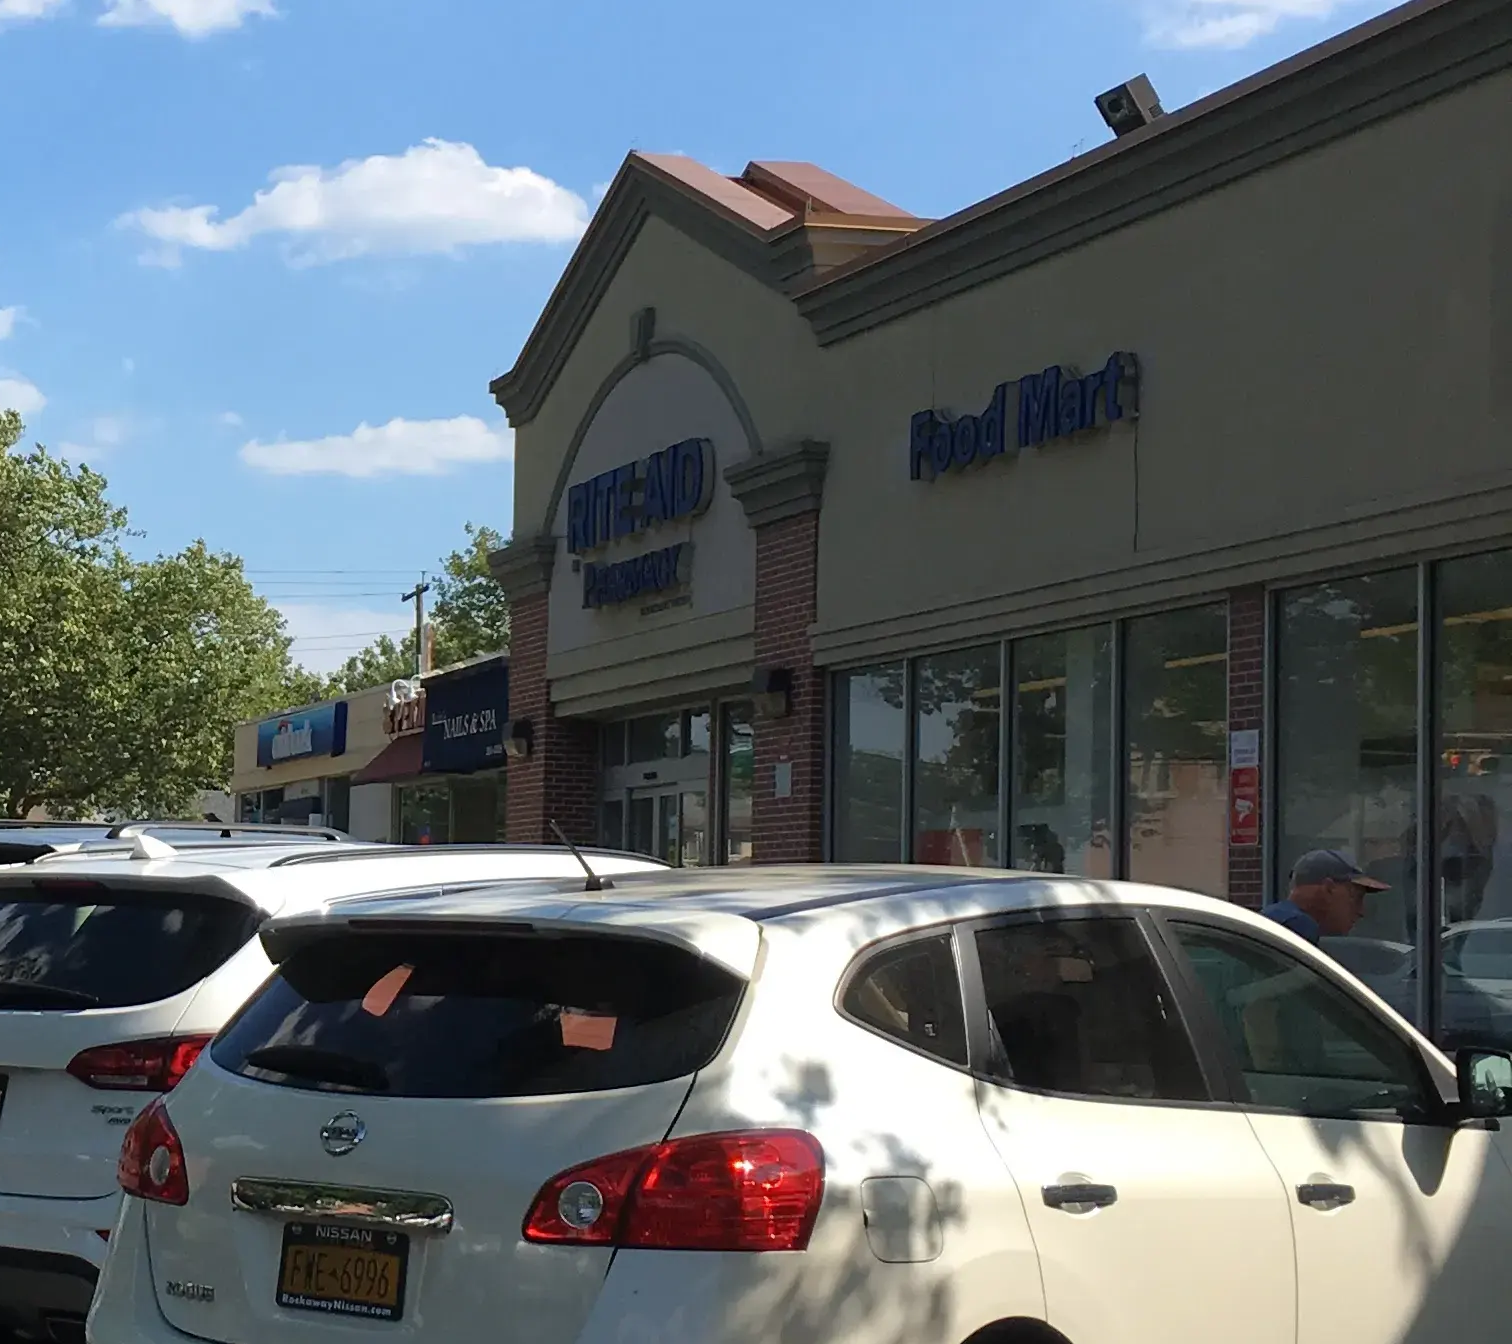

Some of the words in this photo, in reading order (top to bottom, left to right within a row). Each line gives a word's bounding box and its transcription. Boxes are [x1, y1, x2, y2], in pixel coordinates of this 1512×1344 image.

[909, 383, 1007, 482] Food
[1018, 351, 1126, 448] Mart
[567, 461, 639, 554] RITE
[640, 437, 705, 529] AID
[443, 713, 469, 740] NAILS
[469, 712, 479, 734] &
[479, 708, 497, 733] SPA
[90, 1104, 134, 1115] Sport
[315, 1224, 373, 1243] NISSAN
[339, 1256, 390, 1299] 6996
[281, 1292, 392, 1317] RockawayNissan.com
